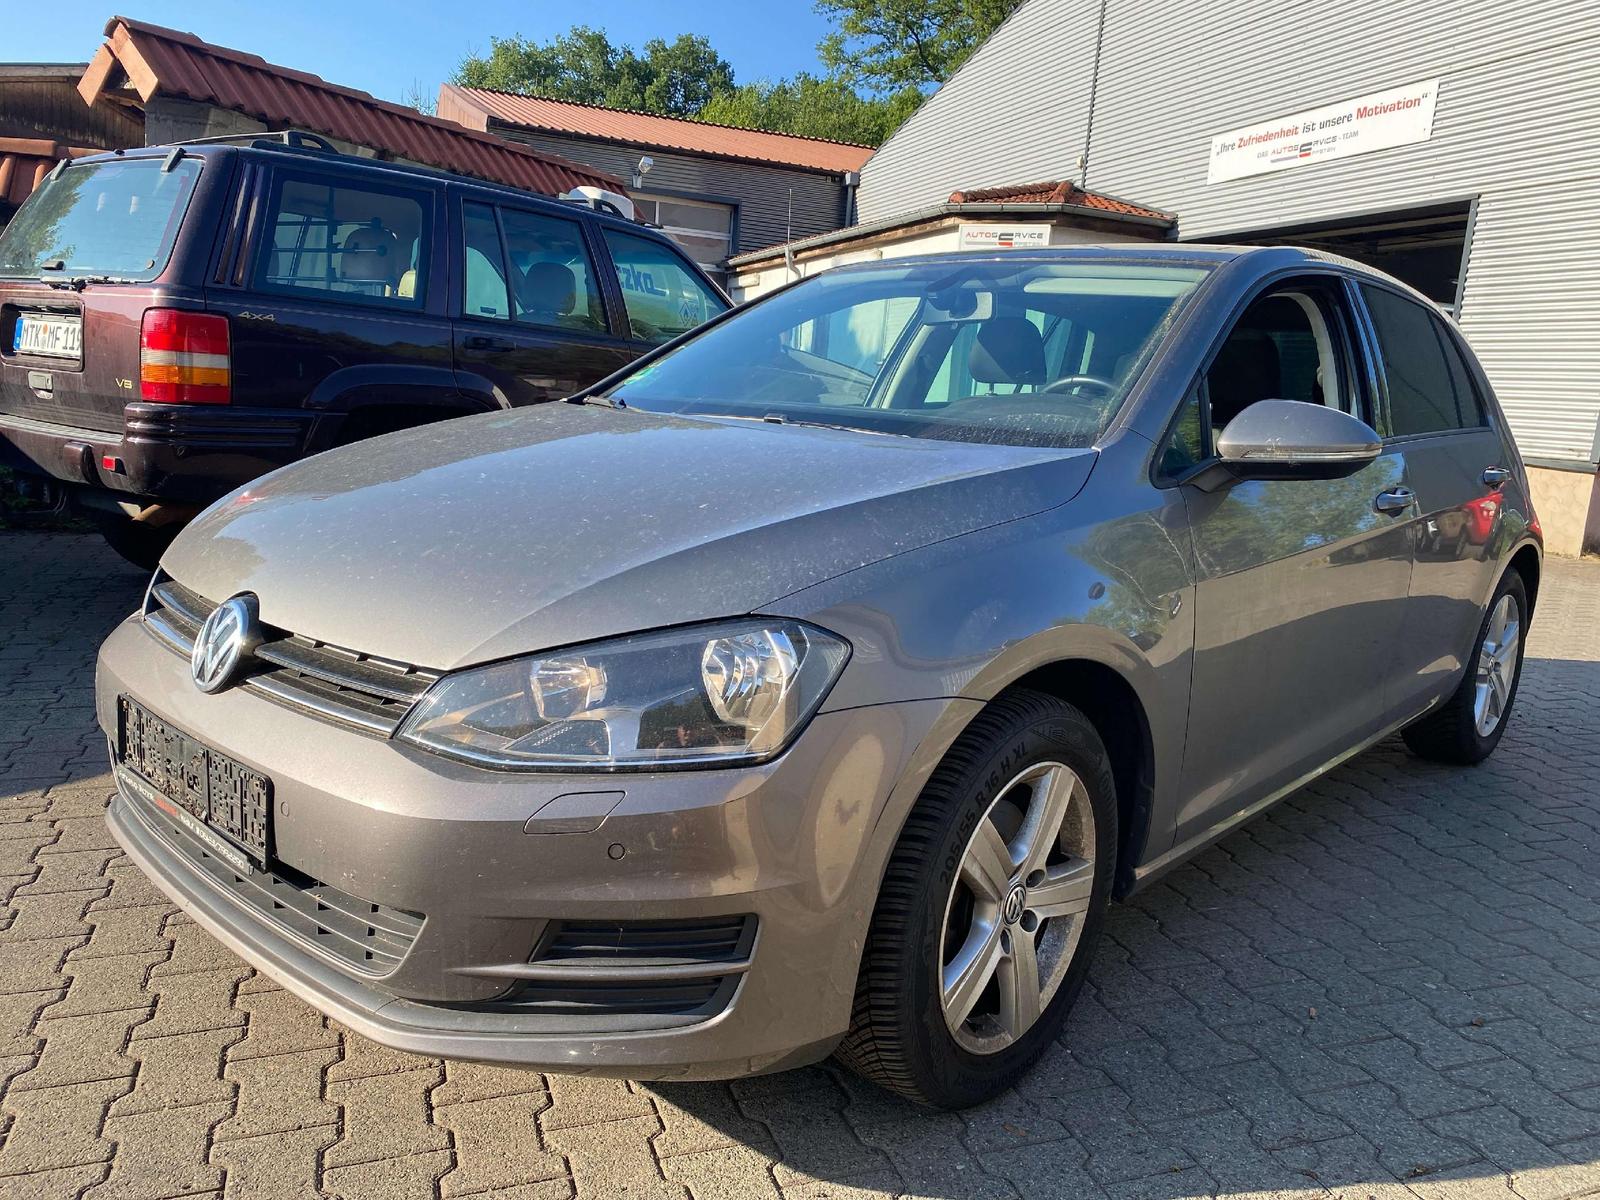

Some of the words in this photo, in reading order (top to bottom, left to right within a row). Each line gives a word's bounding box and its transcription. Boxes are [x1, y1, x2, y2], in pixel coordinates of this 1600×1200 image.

[1237, 125, 1299, 150] Zufriedenheit
[1302, 121, 1317, 134] ist
[1319, 112, 1353, 130] unsere
[22, 322, 42, 348] MTK
[47, 325, 62, 350] MF
[939, 807, 977, 885] 205/55
[985, 769, 1000, 793] 16
